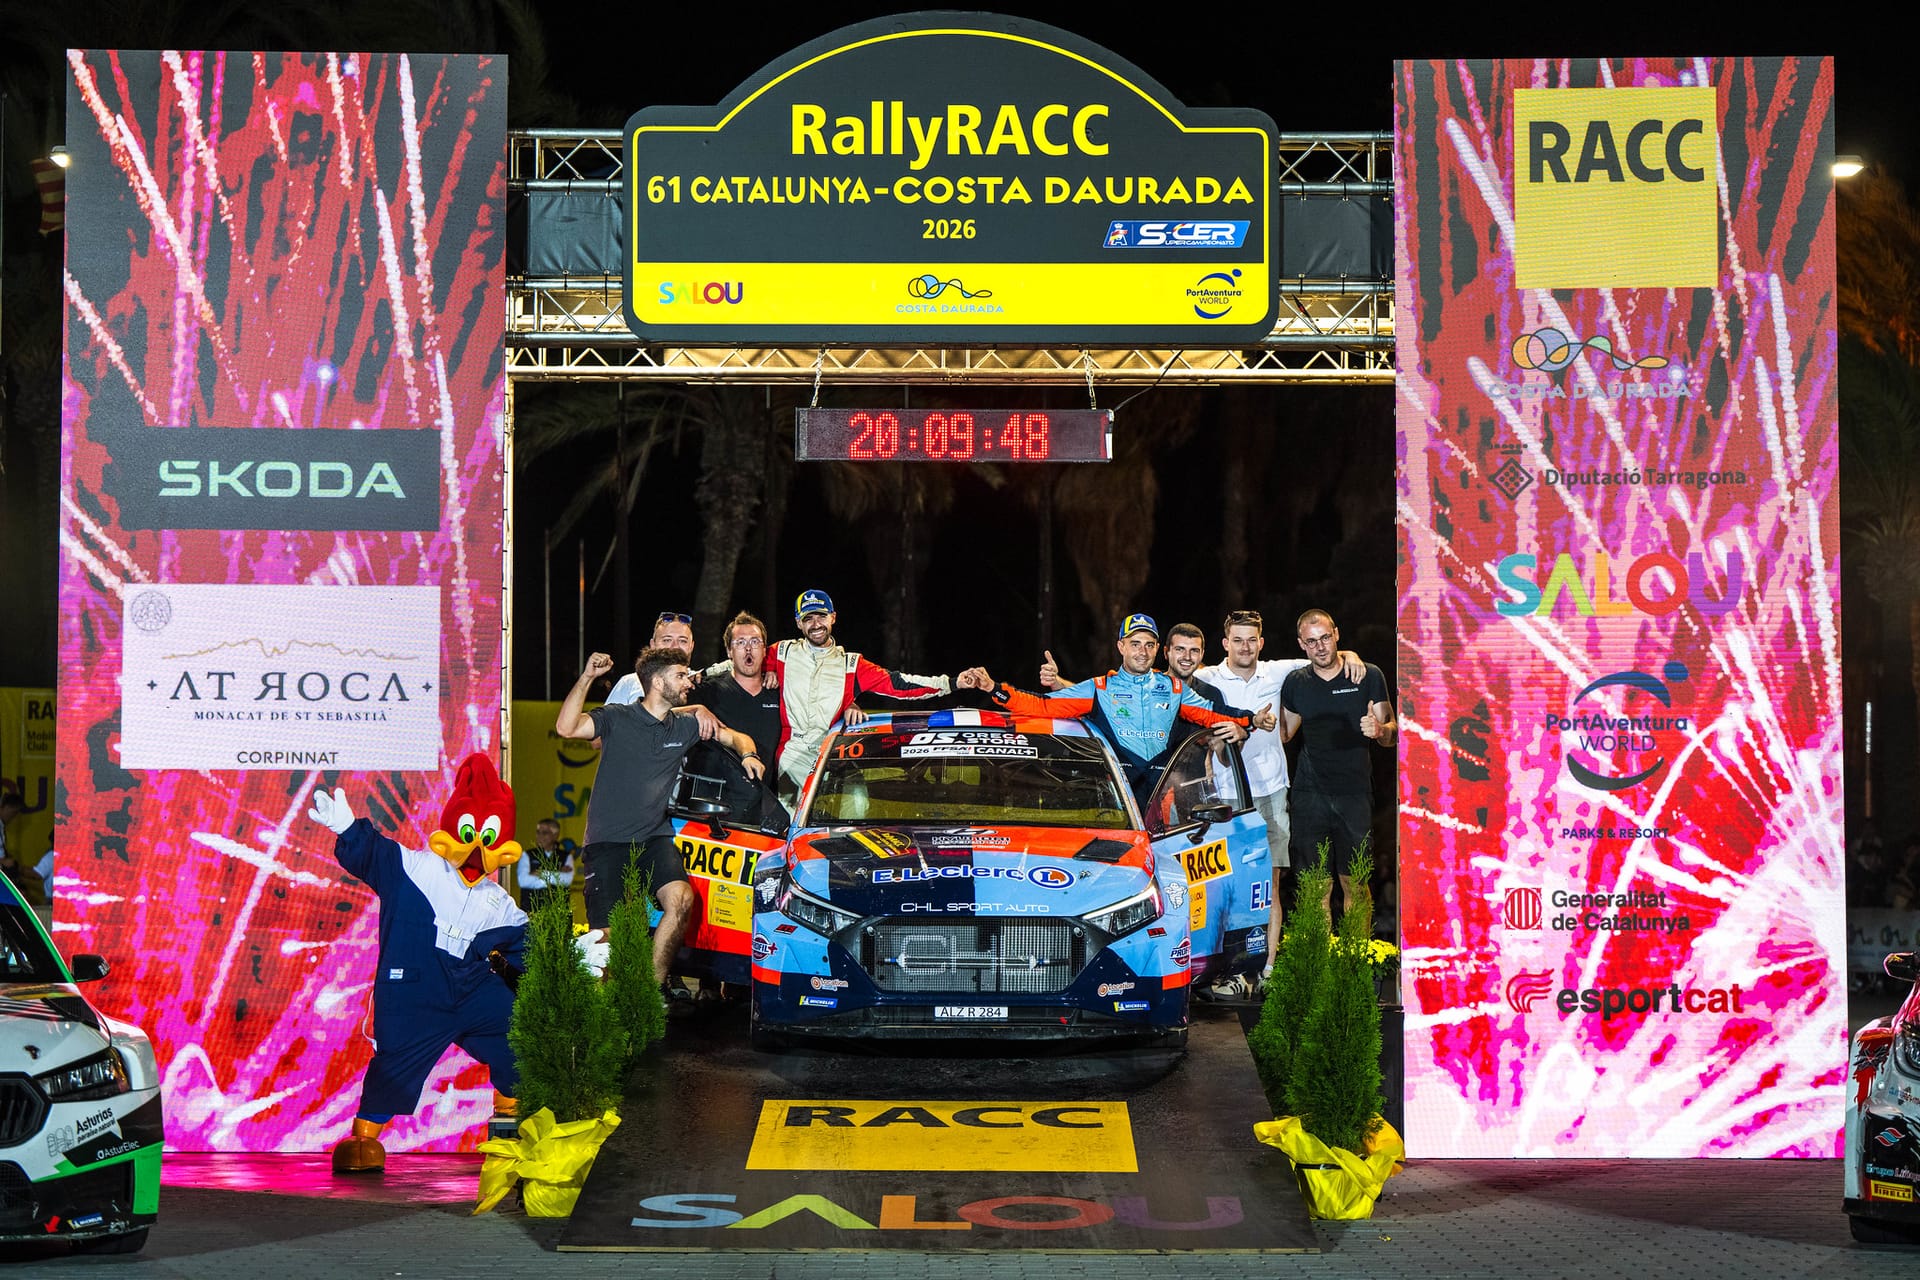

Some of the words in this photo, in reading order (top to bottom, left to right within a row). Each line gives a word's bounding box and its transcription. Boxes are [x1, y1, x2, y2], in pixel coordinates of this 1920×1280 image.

[791, 101, 1110, 170] RallyRACC
[1529, 119, 1704, 183] RACC
[647, 176, 682, 204] 61
[1045, 176, 1254, 204] DAURADA
[922, 219, 976, 240] 2026
[1137, 223, 1236, 245] S-CER
[659, 282, 743, 305] SALOU
[1186, 288, 1242, 297] PortAventura
[896, 304, 937, 313] COSTA
[941, 304, 1004, 313] DAURADA
[1488, 381, 1566, 399] COSTA
[1573, 381, 1692, 399] DAURADA
[849, 413, 1050, 459] 20:09:48
[1545, 467, 1641, 488] Diputació
[1645, 468, 1746, 489] Tarragona
[1497, 552, 1742, 617] SALOU
[27, 701, 56, 720] RA
[194, 711, 263, 721] MONACAT
[270, 711, 289, 721] DE
[295, 711, 312, 721] ST
[1546, 714, 1688, 731] PortAventura
[836, 743, 864, 759] 10
[976, 748, 1034, 756] CANAL+
[1579, 735, 1656, 751] WORLD
[237, 751, 339, 764] CORPINNAT
[1562, 829, 1603, 838] PARKS
[1607, 829, 1616, 838] &
[1619, 828, 1669, 838] RESORT
[680, 840, 736, 878] RACC
[749, 852, 758, 885] 1
[1186, 843, 1226, 881] RACC
[872, 865, 1024, 884] E.Leclerc
[901, 903, 943, 912] CHL
[947, 902, 1003, 912] SPORT
[1005, 904, 1049, 912] AUTO
[1551, 891, 1666, 907] Generalitat
[1552, 913, 1577, 931] de
[1584, 913, 1690, 934] Catalunya
[940, 1007, 964, 1017] ALZ
[968, 1007, 975, 1017] R
[979, 1007, 1002, 1017] 284
[1556, 984, 1744, 1020] esportcat
[76, 1107, 113, 1134] Asturias
[784, 1106, 1106, 1129] RACC
[1874, 1184, 1911, 1199] PIRELLI
[630, 1194, 1244, 1230] SALOU
